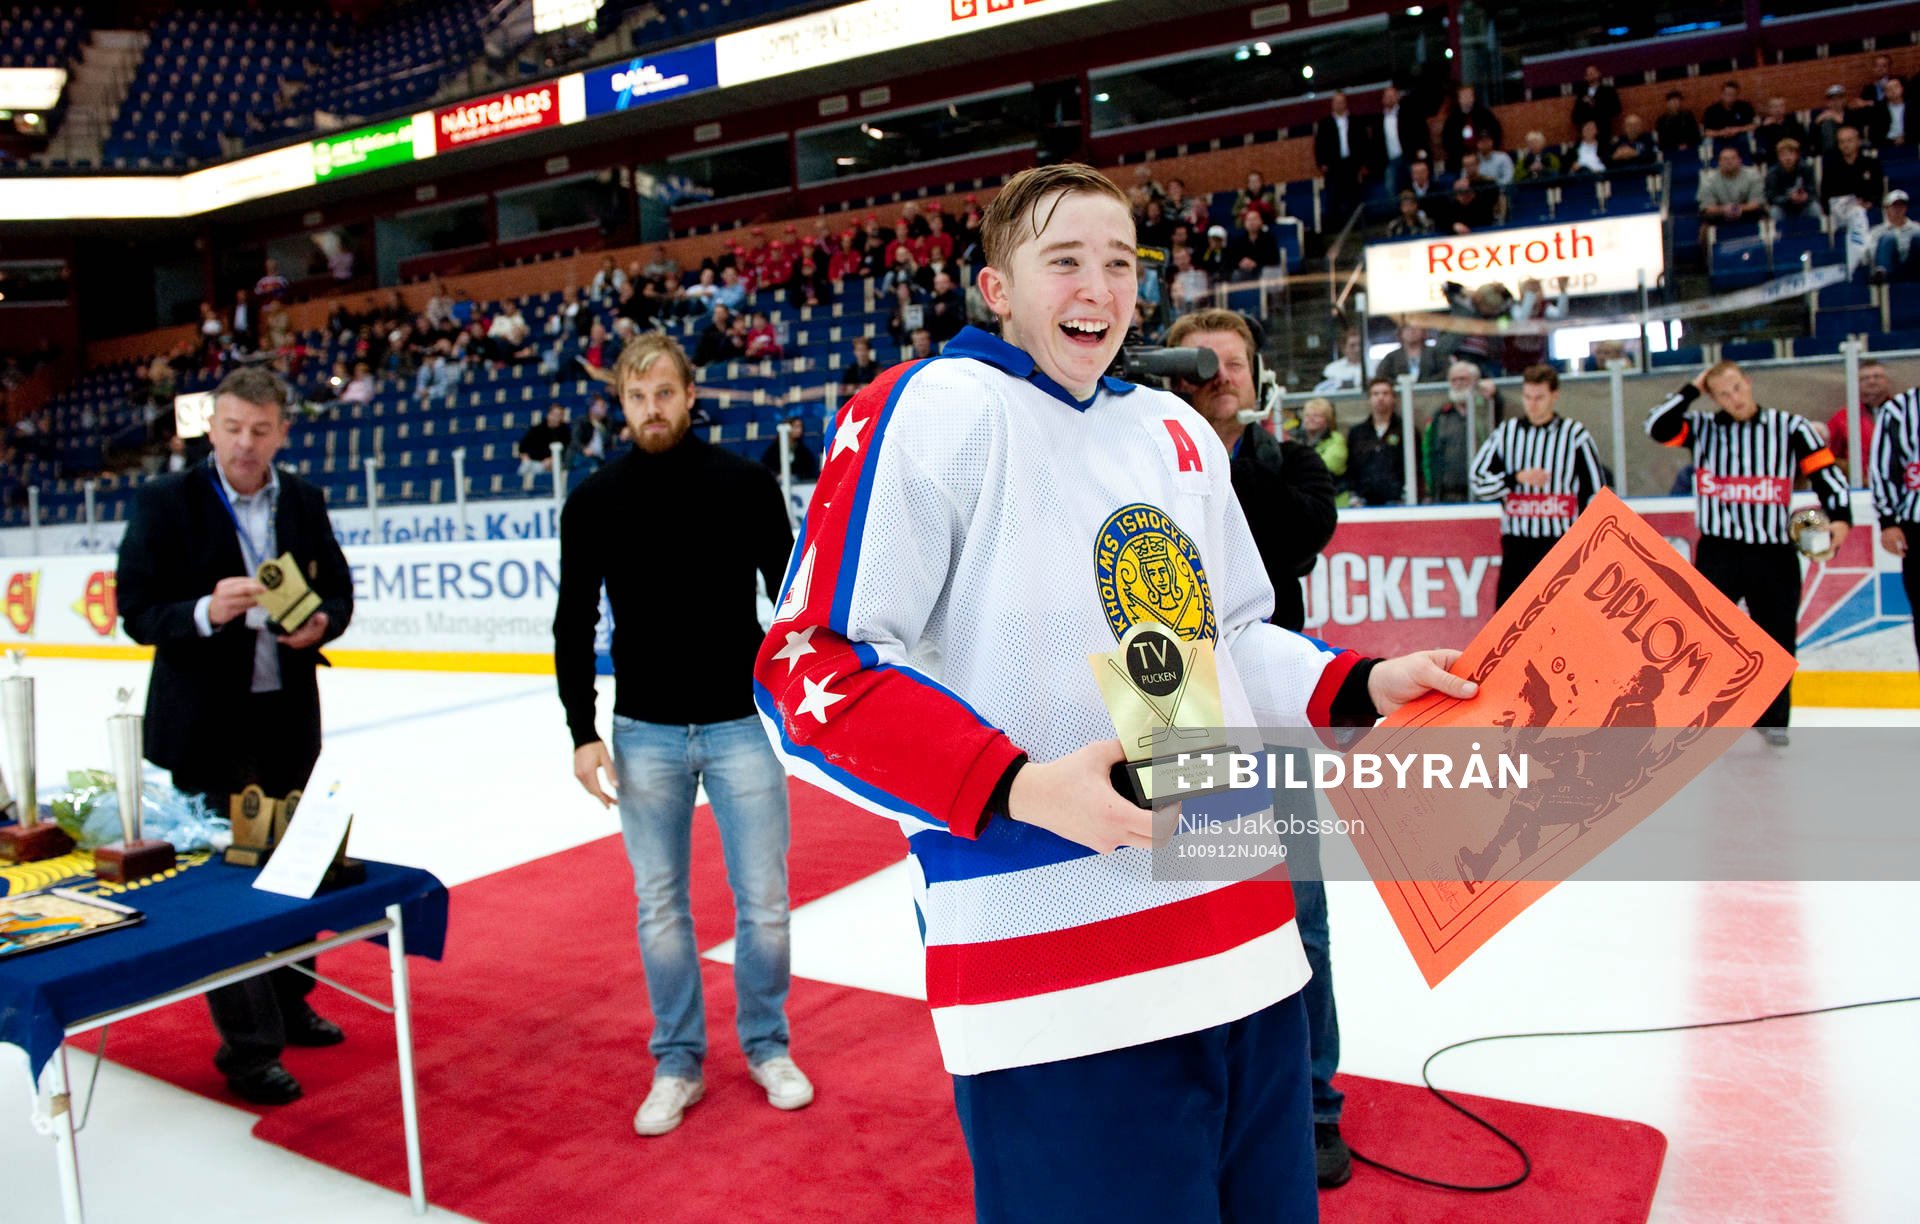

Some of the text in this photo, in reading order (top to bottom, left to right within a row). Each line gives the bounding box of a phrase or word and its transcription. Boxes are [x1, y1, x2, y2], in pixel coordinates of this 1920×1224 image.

[1427, 228, 1594, 273] Rexroth
[1162, 419, 1203, 472] A
[1116, 510, 1198, 561] ISHOCKEY
[350, 560, 561, 601] EMERSON
[1584, 561, 1712, 696] DIPLOM
[1132, 639, 1168, 669] TV
[1141, 671, 1177, 685] PUCKEN
